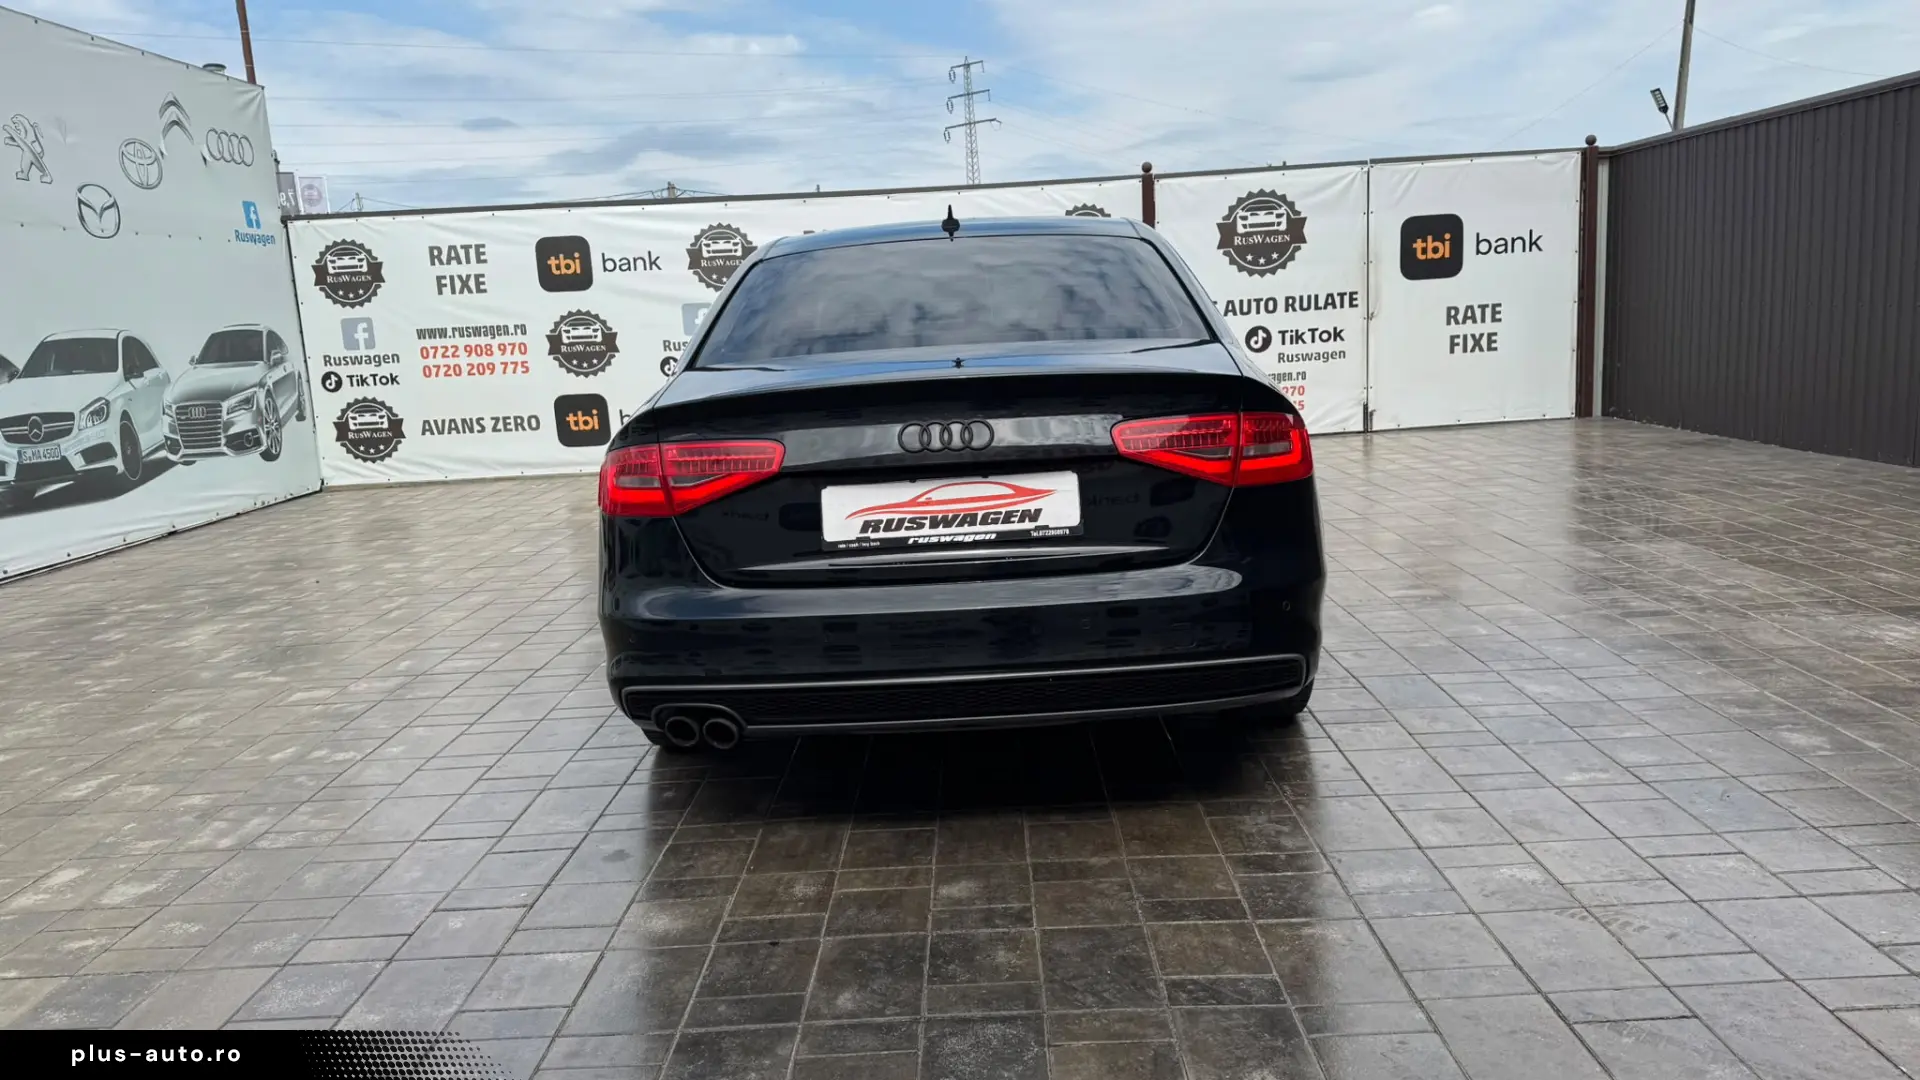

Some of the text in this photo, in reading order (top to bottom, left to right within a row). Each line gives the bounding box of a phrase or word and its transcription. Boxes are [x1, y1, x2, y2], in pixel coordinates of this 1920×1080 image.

[234, 229, 276, 246] Ruswagen
[1412, 229, 1543, 260] tbi bank
[428, 243, 488, 266] RATE
[547, 251, 662, 275] tbi bank
[435, 273, 488, 295] FIXE
[1223, 291, 1359, 317] AUTO RULATE
[1446, 303, 1502, 326] RATE
[416, 323, 528, 340] www.ruswagen.ro
[1278, 326, 1345, 346] TikTok
[420, 342, 528, 360] 0722 908 970
[1449, 332, 1498, 354] FIXE
[323, 353, 400, 368] Ruswagen
[1278, 350, 1346, 364] Ruswagen
[346, 372, 400, 388] TikTok
[422, 361, 530, 378] 0720 209 775
[421, 414, 541, 436] AVANS ZERO
[566, 409, 600, 431] tbi
[859, 507, 1043, 535] RUSWAGEN
[907, 532, 998, 545] ruswagen
